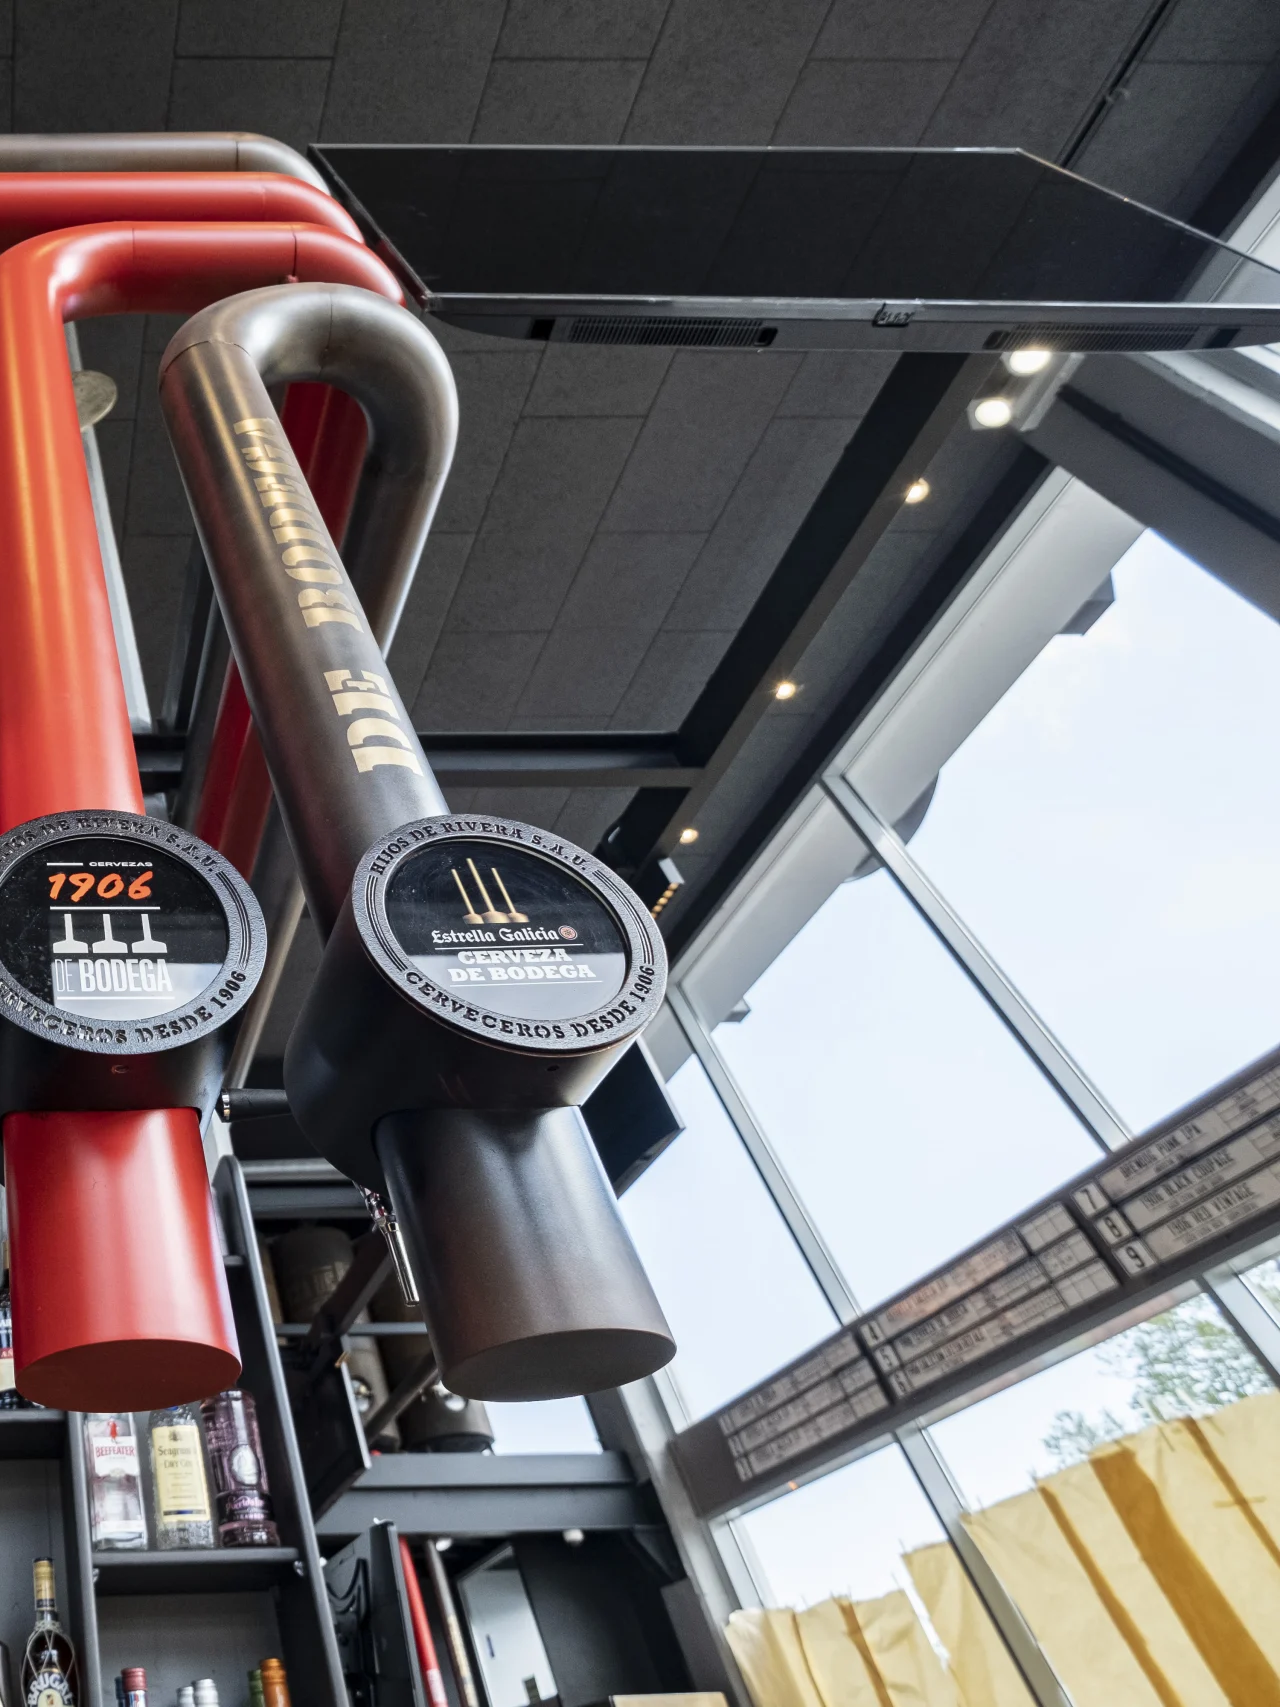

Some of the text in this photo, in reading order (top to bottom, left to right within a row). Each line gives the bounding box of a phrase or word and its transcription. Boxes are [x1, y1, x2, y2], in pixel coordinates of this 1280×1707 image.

[233, 417, 424, 777] DE BODEGA
[40, 819, 70, 836] DE
[75, 817, 161, 838] RIVERA
[370, 820, 587, 876] HIJOS DE RIVERA S.A.U.
[48, 871, 154, 903] 1906
[431, 925, 559, 944] Estrella Galicia
[457, 947, 573, 965] CERVEZA
[54, 958, 174, 993] DE BODEGA
[447, 964, 597, 983] DE BODEGA
[135, 1005, 213, 1043] DESDE
[209, 970, 248, 1009] 1906
[405, 965, 656, 1040] CERVECEROS DESDE 1906
[1080, 1187, 1098, 1211] 7
[1104, 1215, 1123, 1239] 8
[1125, 1246, 1147, 1270] 9
[95, 1446, 137, 1458] BEEFEATER
[27, 1672, 73, 1706] BRUGAL
